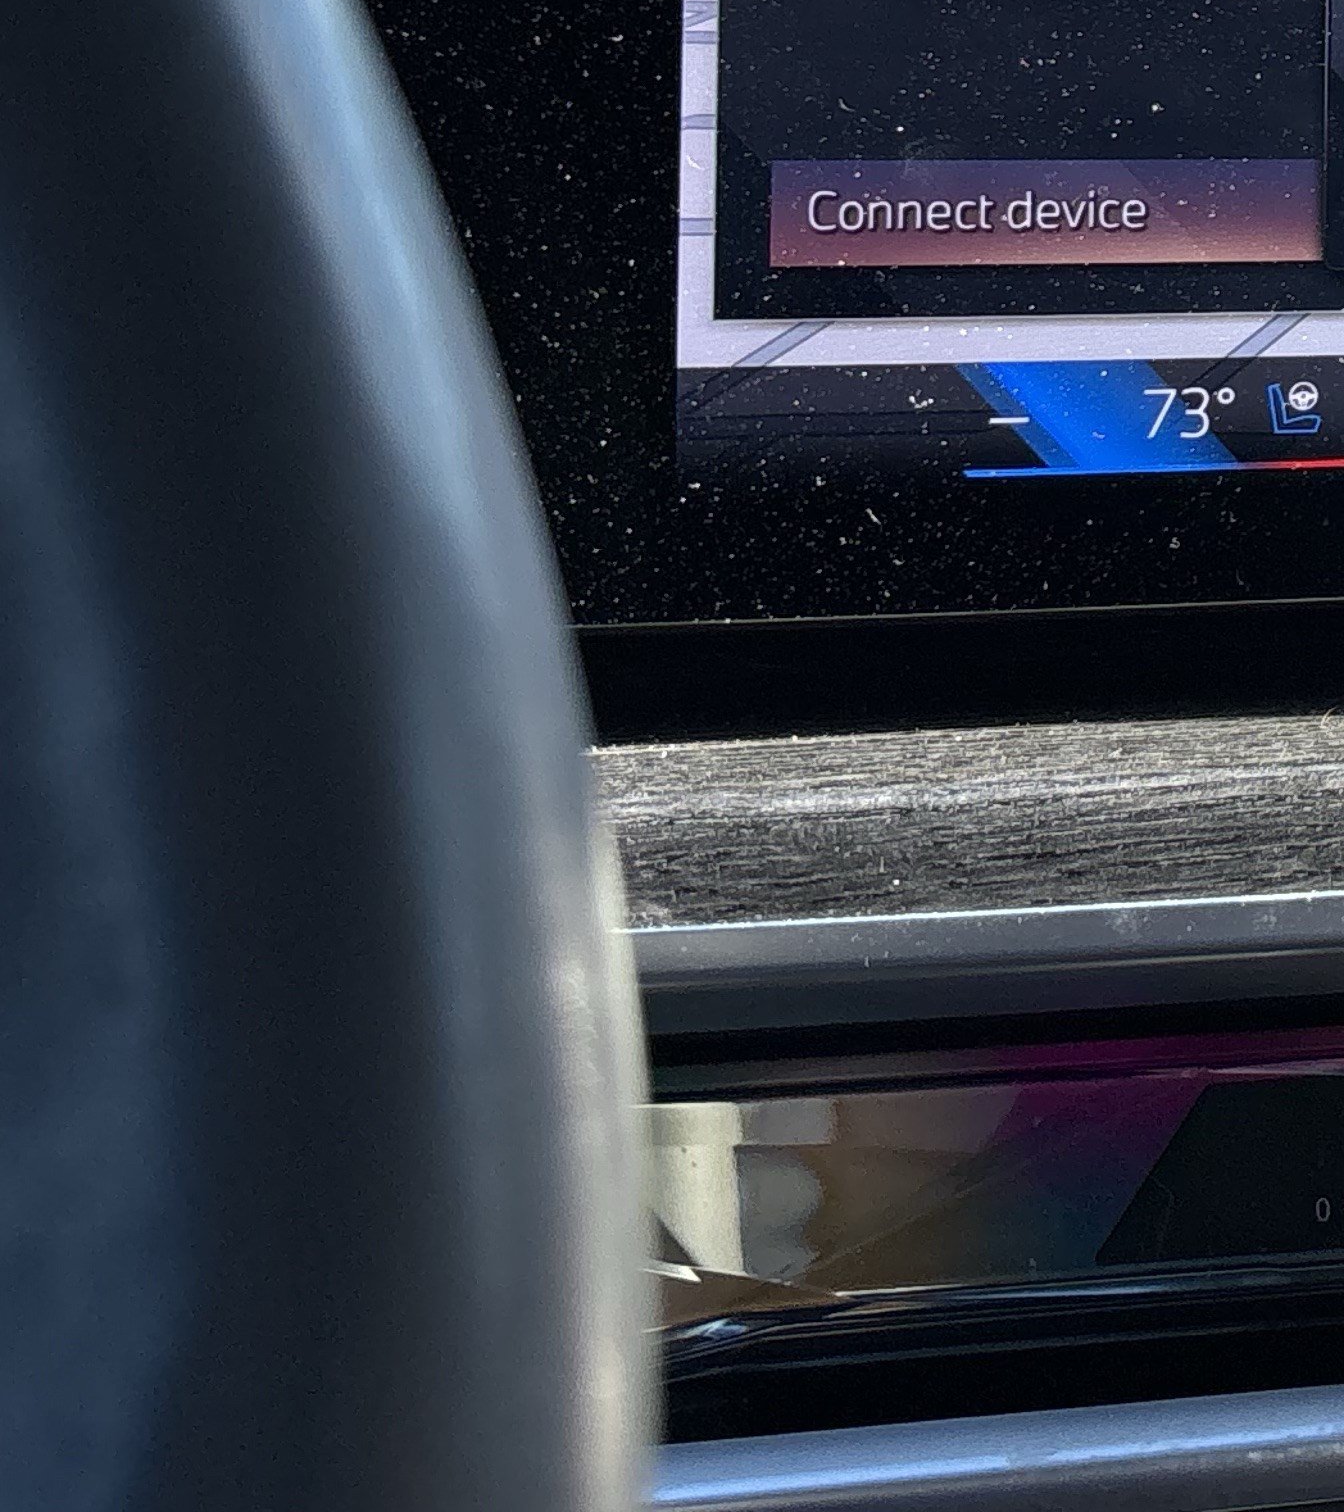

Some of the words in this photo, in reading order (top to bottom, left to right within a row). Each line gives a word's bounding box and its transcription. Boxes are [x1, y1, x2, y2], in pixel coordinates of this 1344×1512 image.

[808, 190, 995, 231] Connect
[1007, 189, 1147, 230] device
[1143, 386, 1236, 439] 73°
[1315, 1196, 1331, 1222] 0
